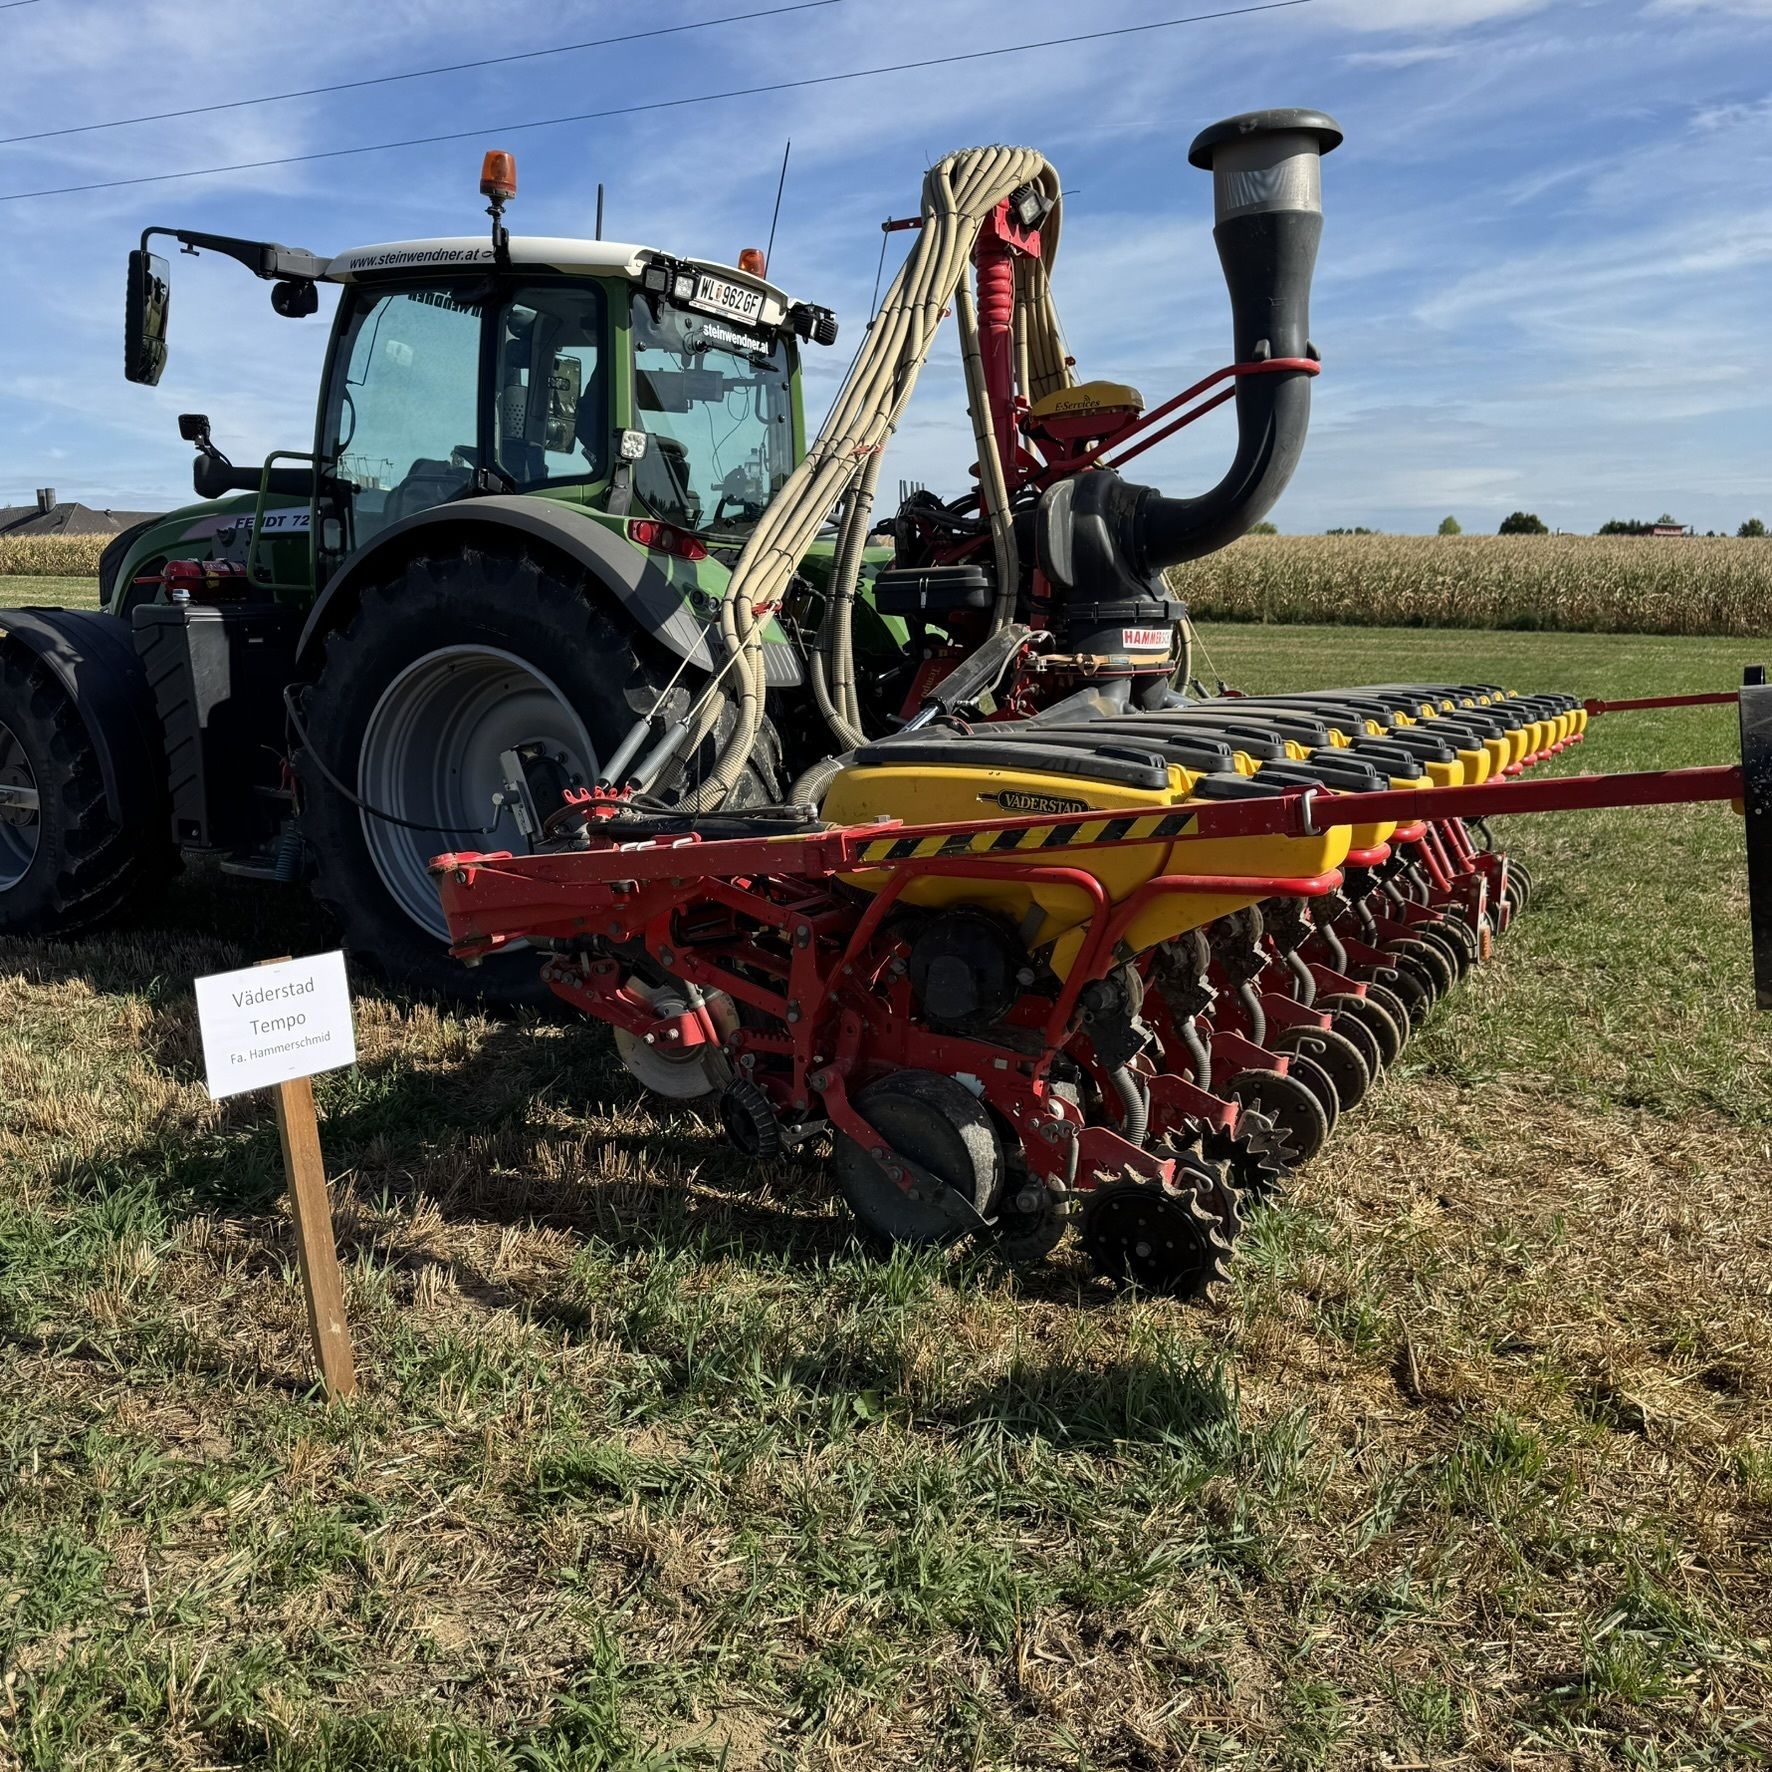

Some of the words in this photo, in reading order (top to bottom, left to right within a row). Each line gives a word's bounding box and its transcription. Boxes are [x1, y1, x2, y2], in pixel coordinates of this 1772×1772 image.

[350, 248, 480, 269] www.steinwendner.at
[700, 278, 714, 301] WL
[703, 323, 769, 355] steinwendner.at
[1005, 792, 1083, 814] VÄDERSTAD
[232, 977, 315, 1008] Väderstad
[250, 1013, 306, 1035] Tempo
[230, 1053, 247, 1064] Fa.
[249, 1031, 331, 1060] Hammerschmid
